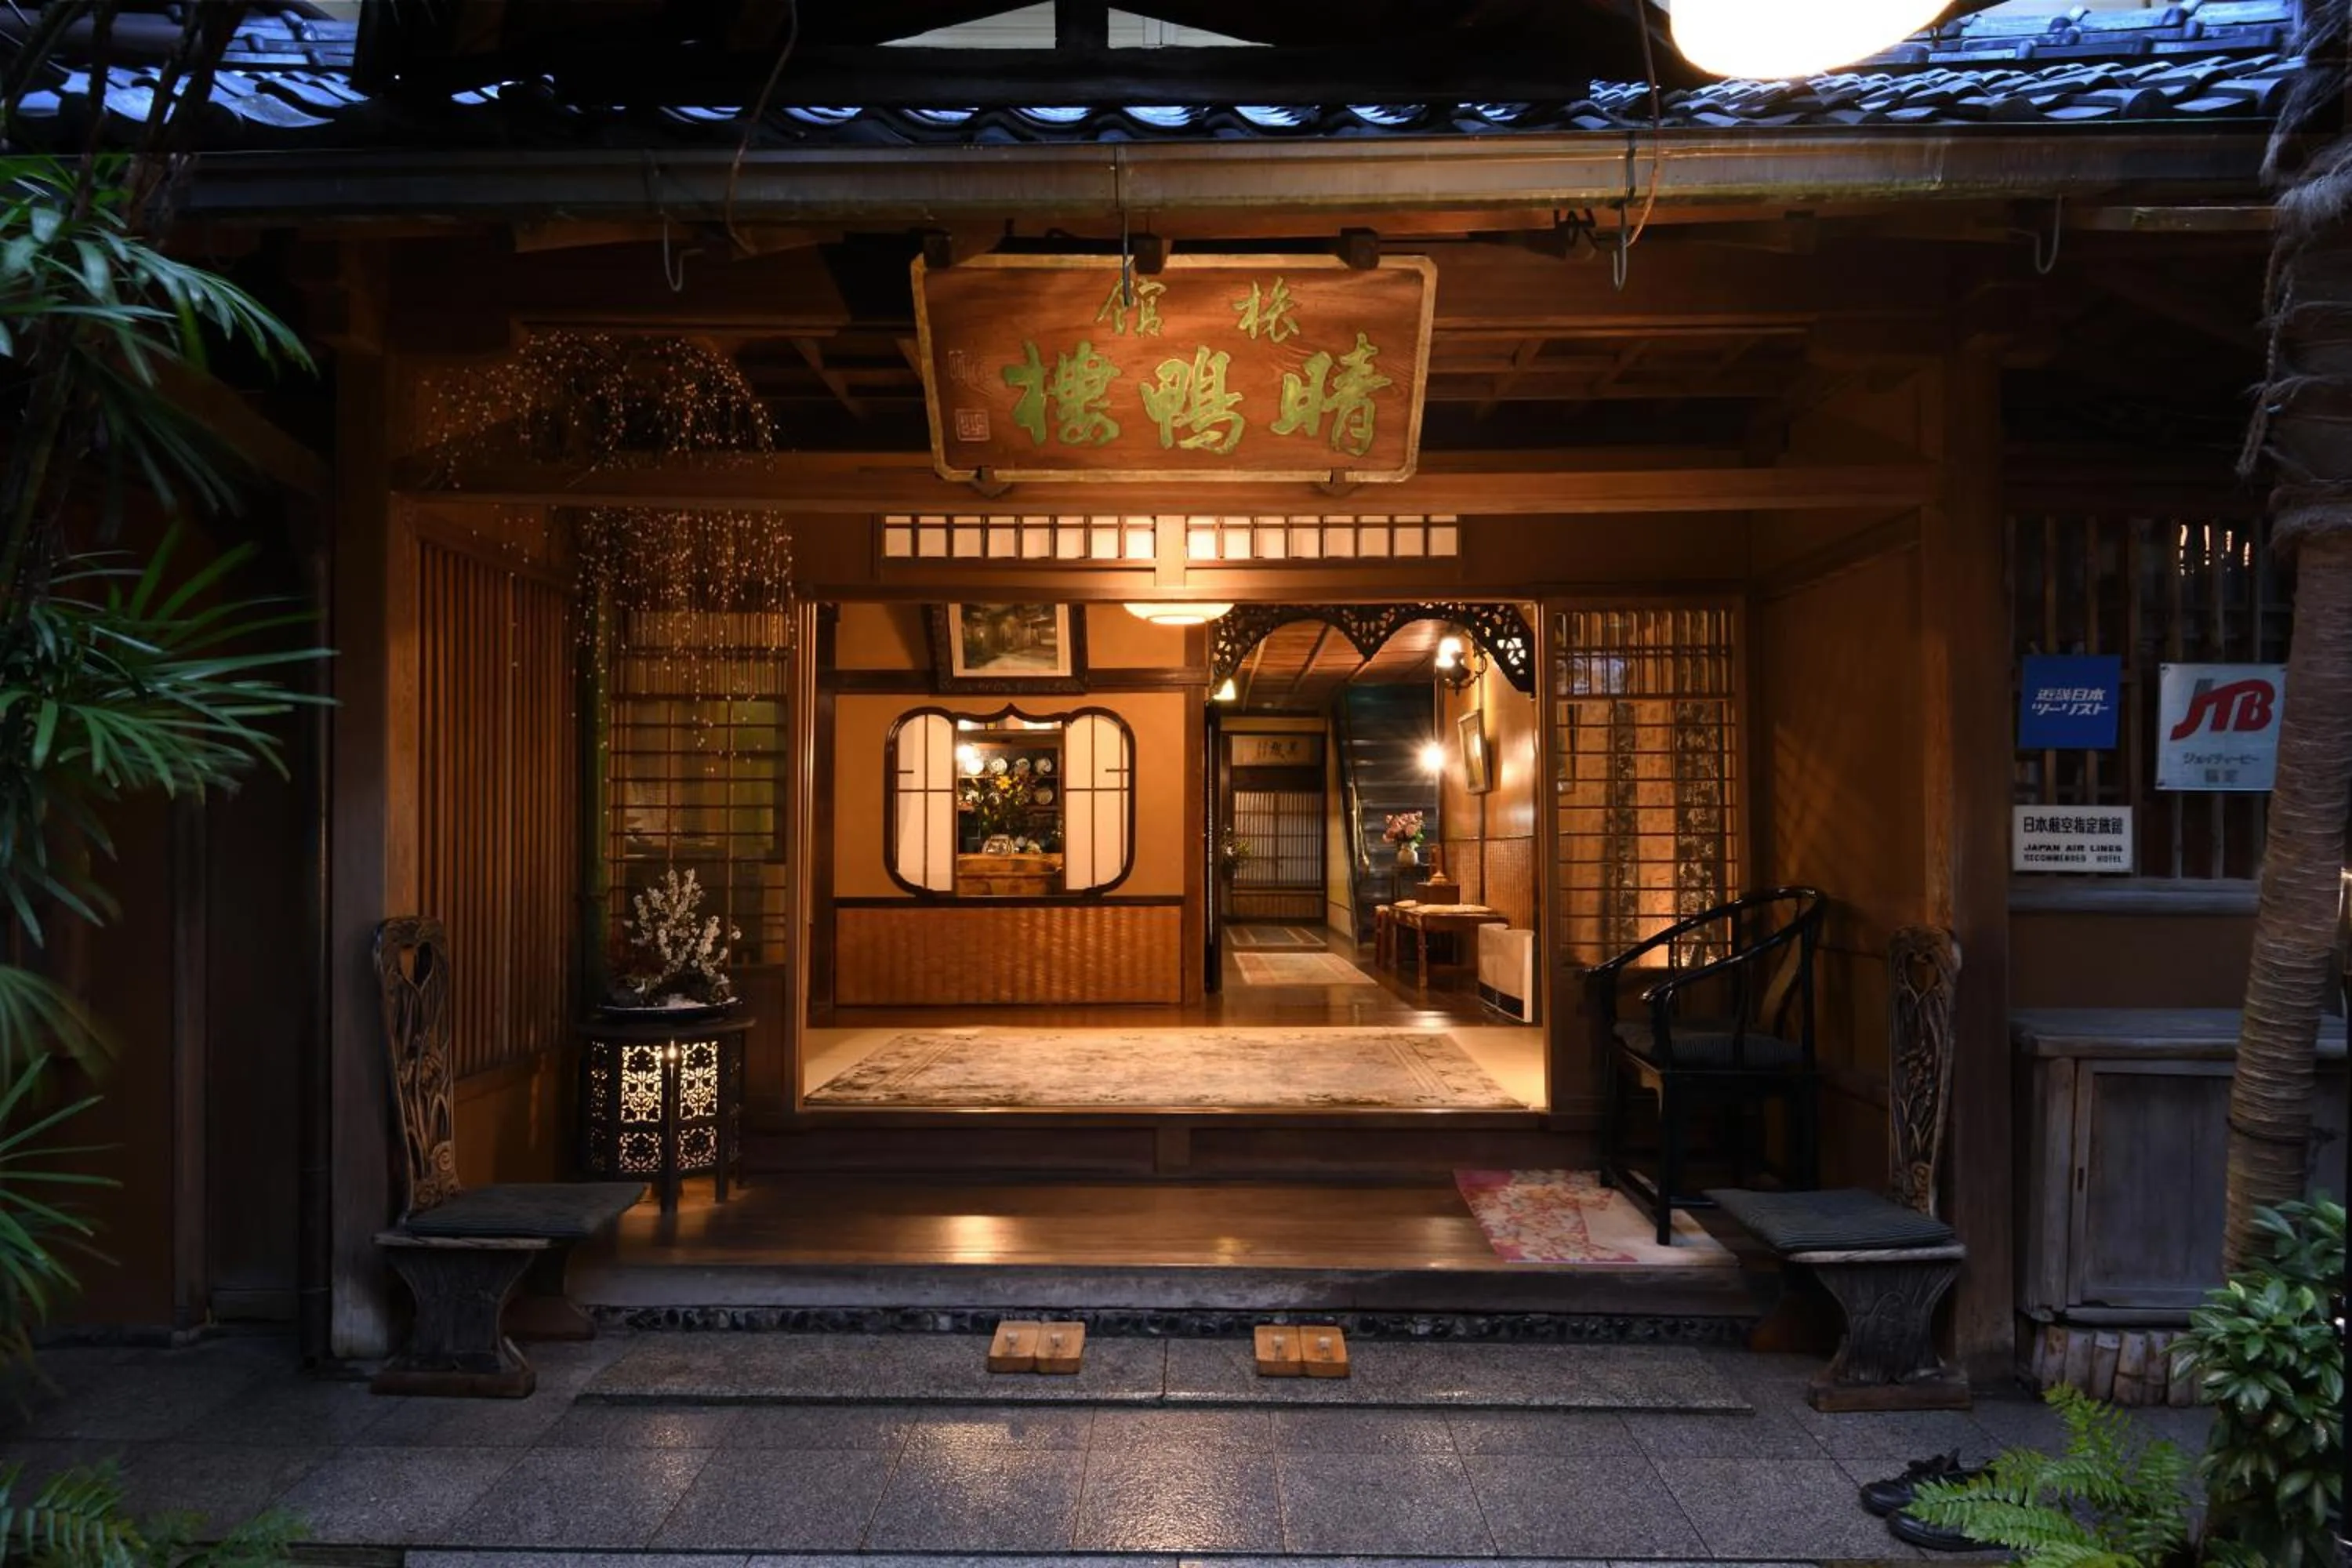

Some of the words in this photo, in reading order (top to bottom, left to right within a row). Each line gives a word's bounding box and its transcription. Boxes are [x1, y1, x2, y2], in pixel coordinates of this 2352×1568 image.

[2035, 688, 2106, 701] 近畿日本
[2031, 702, 2109, 716] ツーリスト
[2169, 678, 2275, 740] JTB
[2024, 816, 2123, 834] 日本航空指定旅館
[2024, 844, 2061, 852] JAPAN
